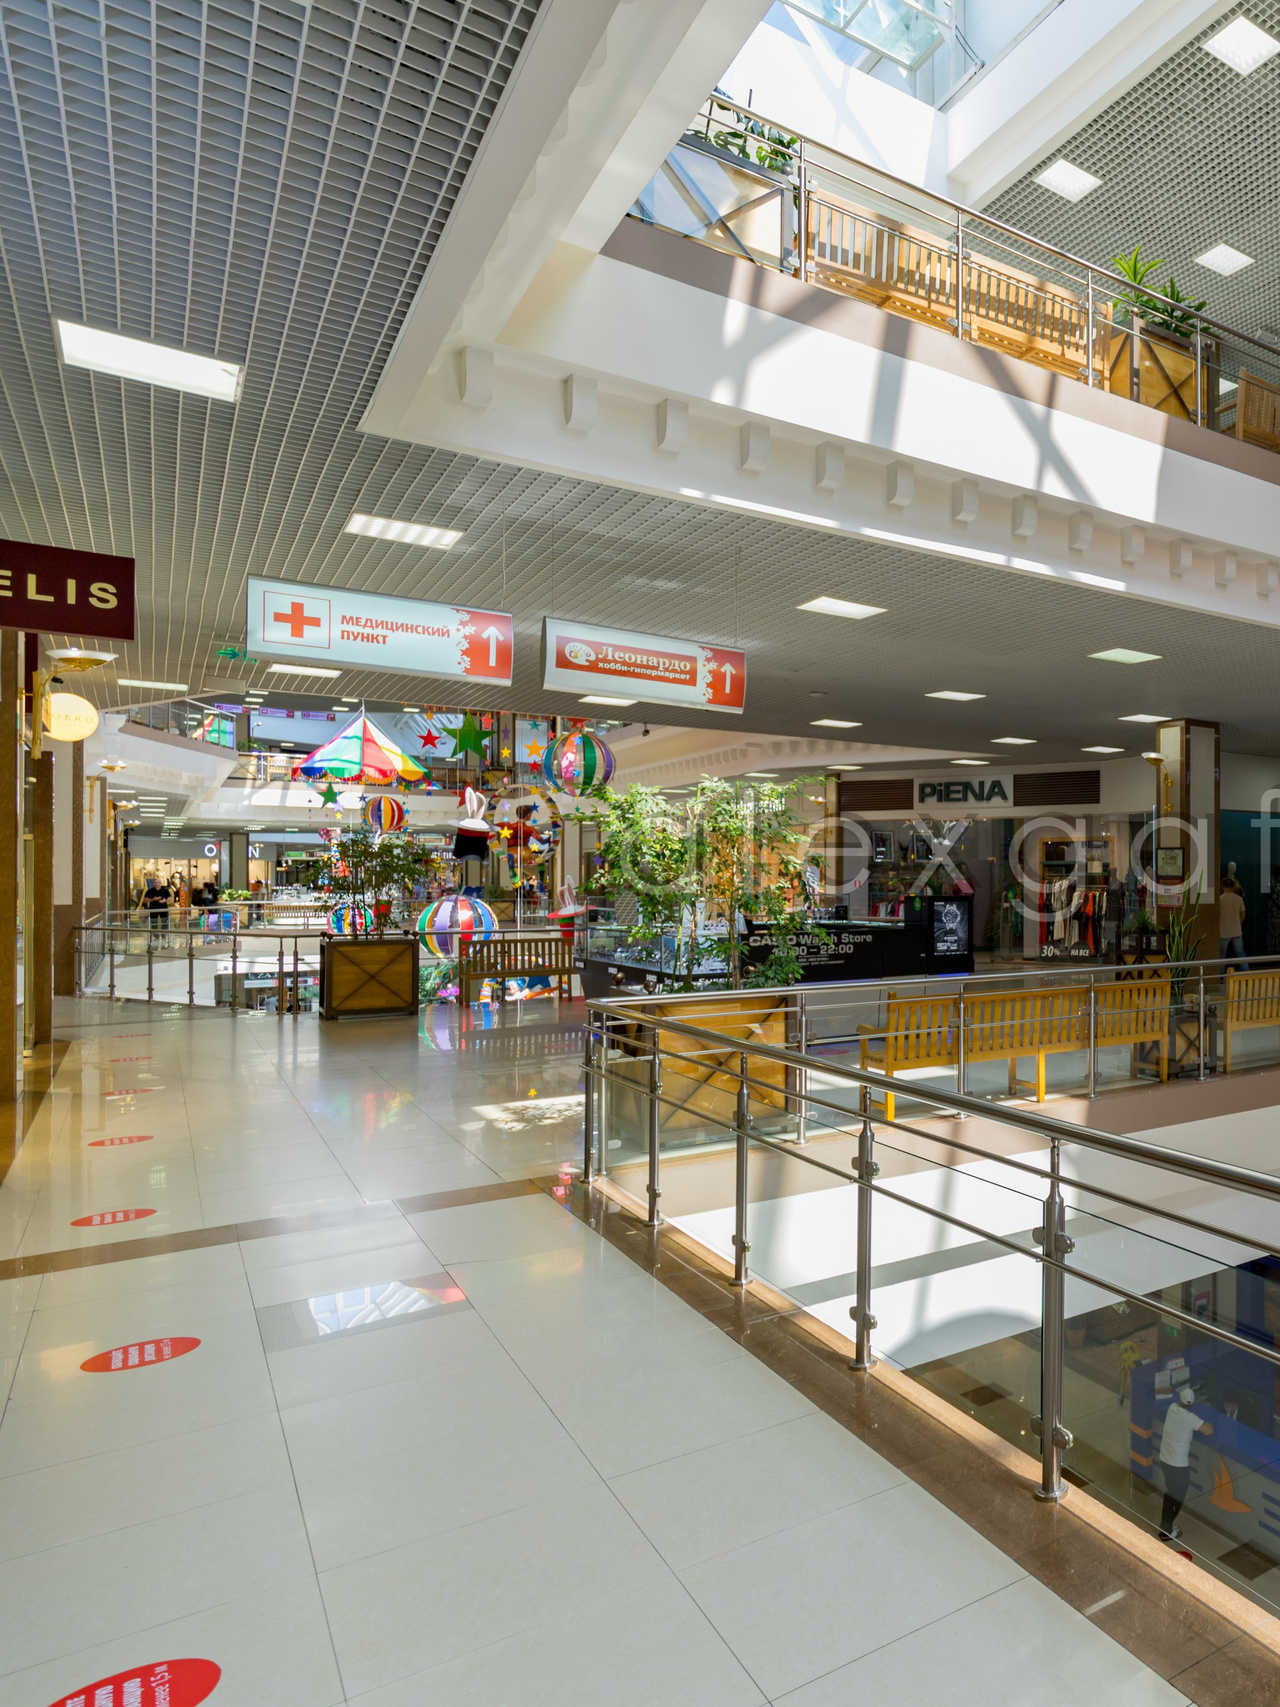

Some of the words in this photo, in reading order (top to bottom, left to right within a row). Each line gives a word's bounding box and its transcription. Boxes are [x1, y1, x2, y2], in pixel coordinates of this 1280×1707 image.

[340, 614, 451, 639] МЕДИЦИНСКИЙ
[340, 629, 389, 645] ПУНКТ
[598, 645, 691, 672] Леонардо
[597, 661, 691, 680] хобби-гипермаркет
[51, 712, 94, 724] OBRO
[918, 779, 1009, 804] PiENA
[748, 935, 798, 947] CASO
[800, 933, 838, 945] Wah
[841, 933, 873, 943] Store
[772, 945, 808, 957] 100
[820, 943, 854, 954] 22:00
[1041, 945, 1060, 957] 30%
[1079, 949, 1090, 957] ВСЕ
